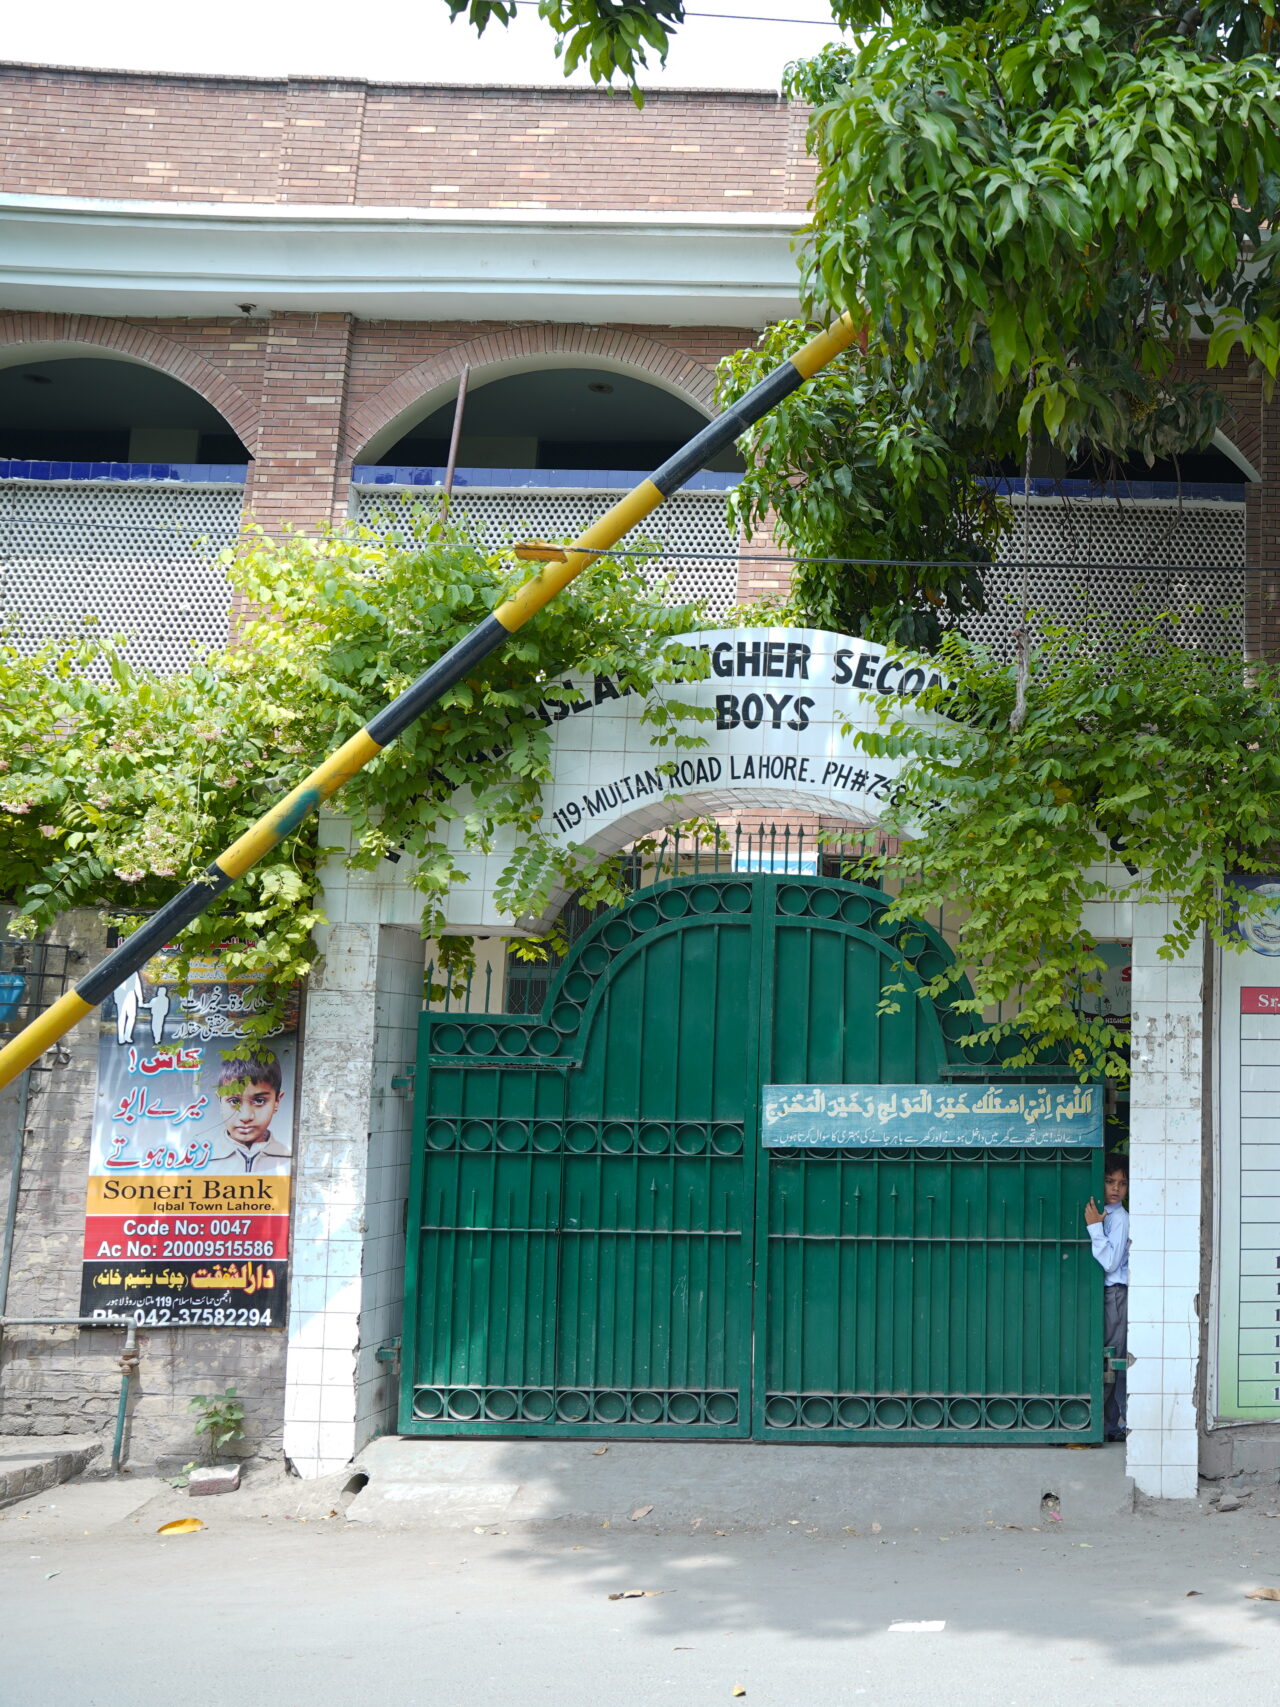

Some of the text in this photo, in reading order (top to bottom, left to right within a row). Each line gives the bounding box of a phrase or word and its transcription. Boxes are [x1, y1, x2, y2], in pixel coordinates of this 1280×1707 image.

[716, 693, 815, 730] BOYS
[553, 767, 664, 833] 119-MULTAN
[670, 757, 722, 788] ROAD
[731, 756, 815, 782] LAHORE.
[1259, 995, 1280, 1007] Sr.
[113, 1087, 207, 1123] میرے ابو
[106, 1138, 210, 1167] زندہ ہوتے
[104, 1179, 272, 1199] Soneri Bank
[154, 1202, 274, 1212] Iqbal Town Lahore.
[124, 1220, 251, 1236] Code No: 0047
[97, 1241, 274, 1257] Ac No: 20009515586
[134, 1309, 272, 1327] 042-37582294
